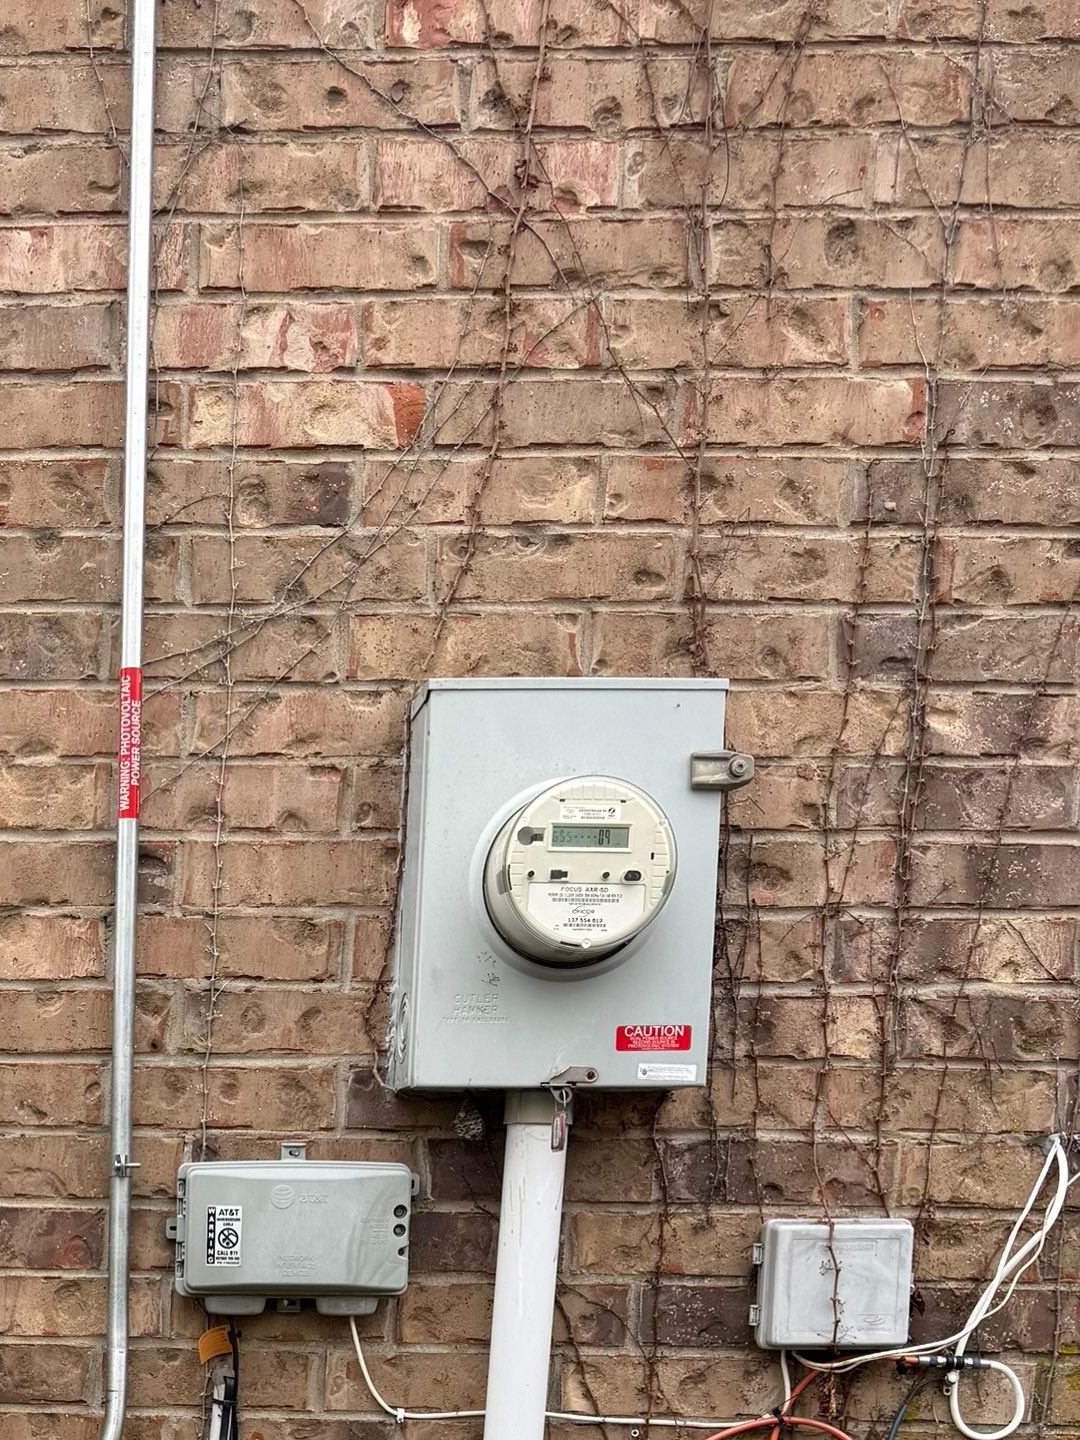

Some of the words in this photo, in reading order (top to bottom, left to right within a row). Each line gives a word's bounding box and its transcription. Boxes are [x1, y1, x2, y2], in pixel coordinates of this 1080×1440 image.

[120, 675, 131, 755] PHOTOVOLTAIC
[131, 700, 141, 745] SOURCE
[119, 756, 131, 811] WARNING:
[130, 747, 140, 786] POWER
[624, 1025, 685, 1037] CAUTION
[218, 1208, 240, 1216] AT&T
[208, 1208, 216, 1264] WARNING
